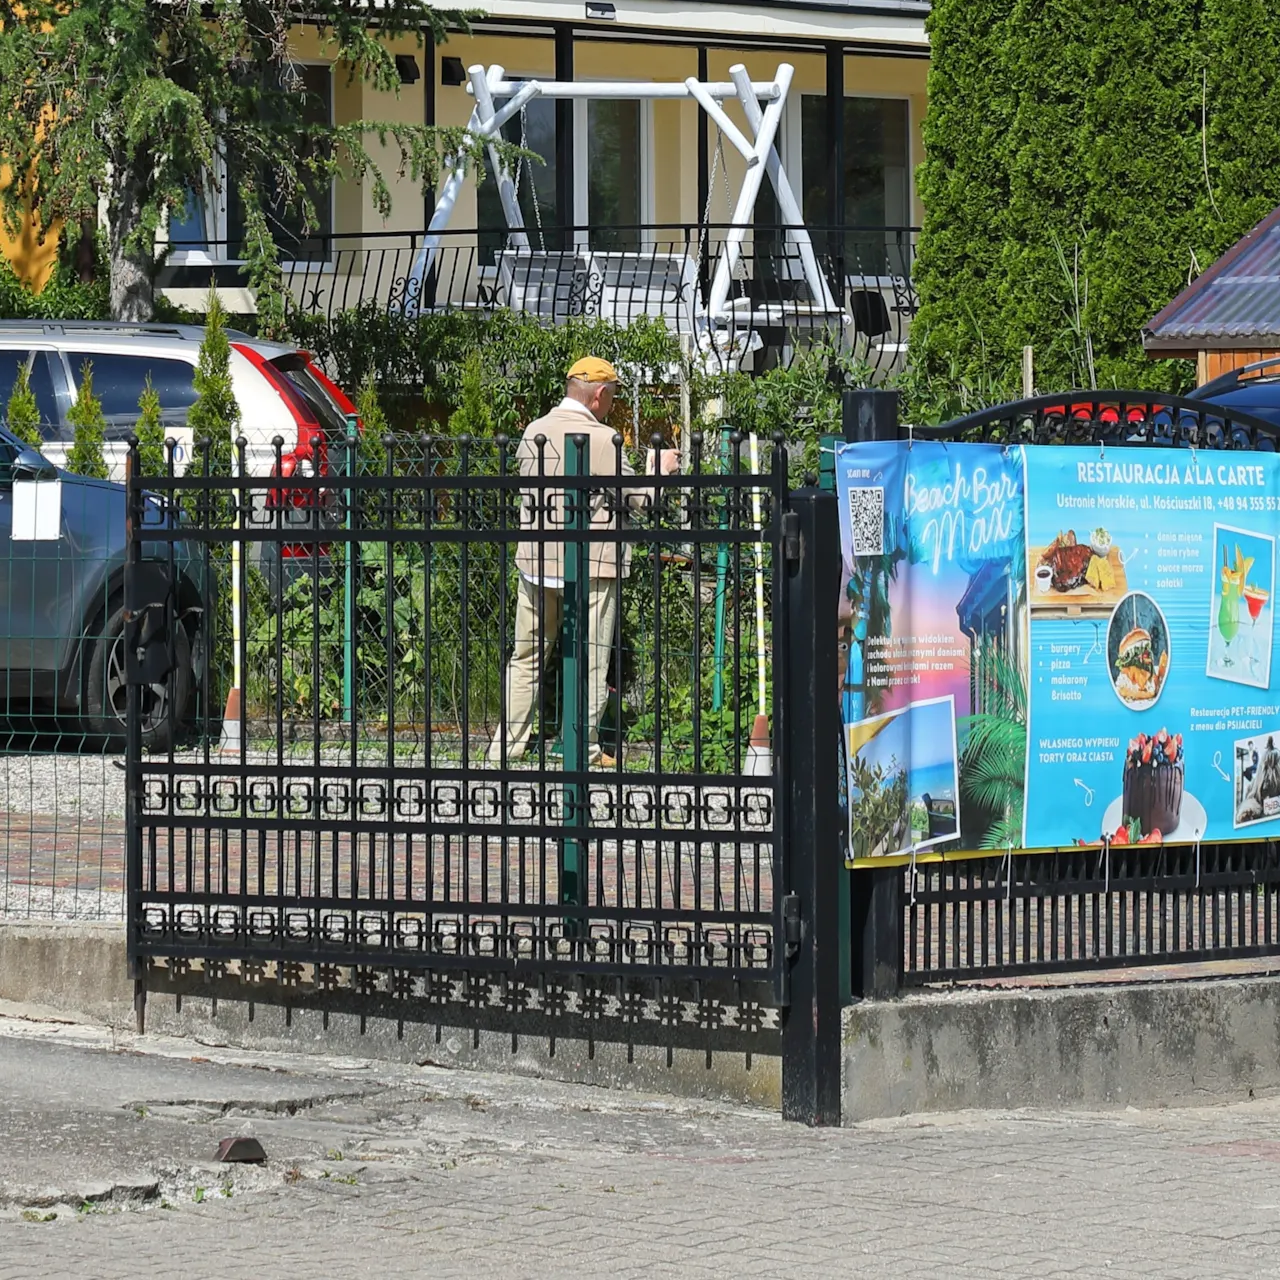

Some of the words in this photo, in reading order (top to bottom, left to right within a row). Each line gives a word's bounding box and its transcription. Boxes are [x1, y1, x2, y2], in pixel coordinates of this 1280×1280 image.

[1077, 462, 1181, 485] RESTAURACJA
[1217, 465, 1265, 486] CARTE
[904, 462, 970, 520] Beach
[973, 467, 1018, 514] Bar
[1056, 493, 1096, 508] Ustronie
[1098, 494, 1139, 511] Morskie,
[1140, 495, 1152, 509] ul.
[1154, 495, 1202, 511] Kościuszki
[1203, 496, 1215, 512] 18,
[1217, 496, 1235, 511] +48
[1236, 496, 1248, 511] 94
[1249, 496, 1265, 511] 355
[1266, 496, 1276, 511] 55
[922, 501, 1013, 575] Max
[1157, 547, 1178, 557] dania
[918, 635, 955, 644] widokiem
[1051, 643, 1081, 656] burgery
[932, 661, 954, 671] razem
[1051, 658, 1071, 672] pizza
[1051, 675, 1088, 687] makarony
[1190, 707, 1230, 718] Restauracja
[1231, 705, 1280, 717] PET-FRIENDLY
[1190, 723, 1195, 731] z
[1195, 722, 1214, 731] menu
[1039, 738, 1083, 749] WŁASNEGO
[1085, 737, 1120, 748] WYPIEKU
[1039, 753, 1065, 763] TORTY
[1066, 752, 1087, 762] ORAZ
[1089, 751, 1114, 761] CIASTA
